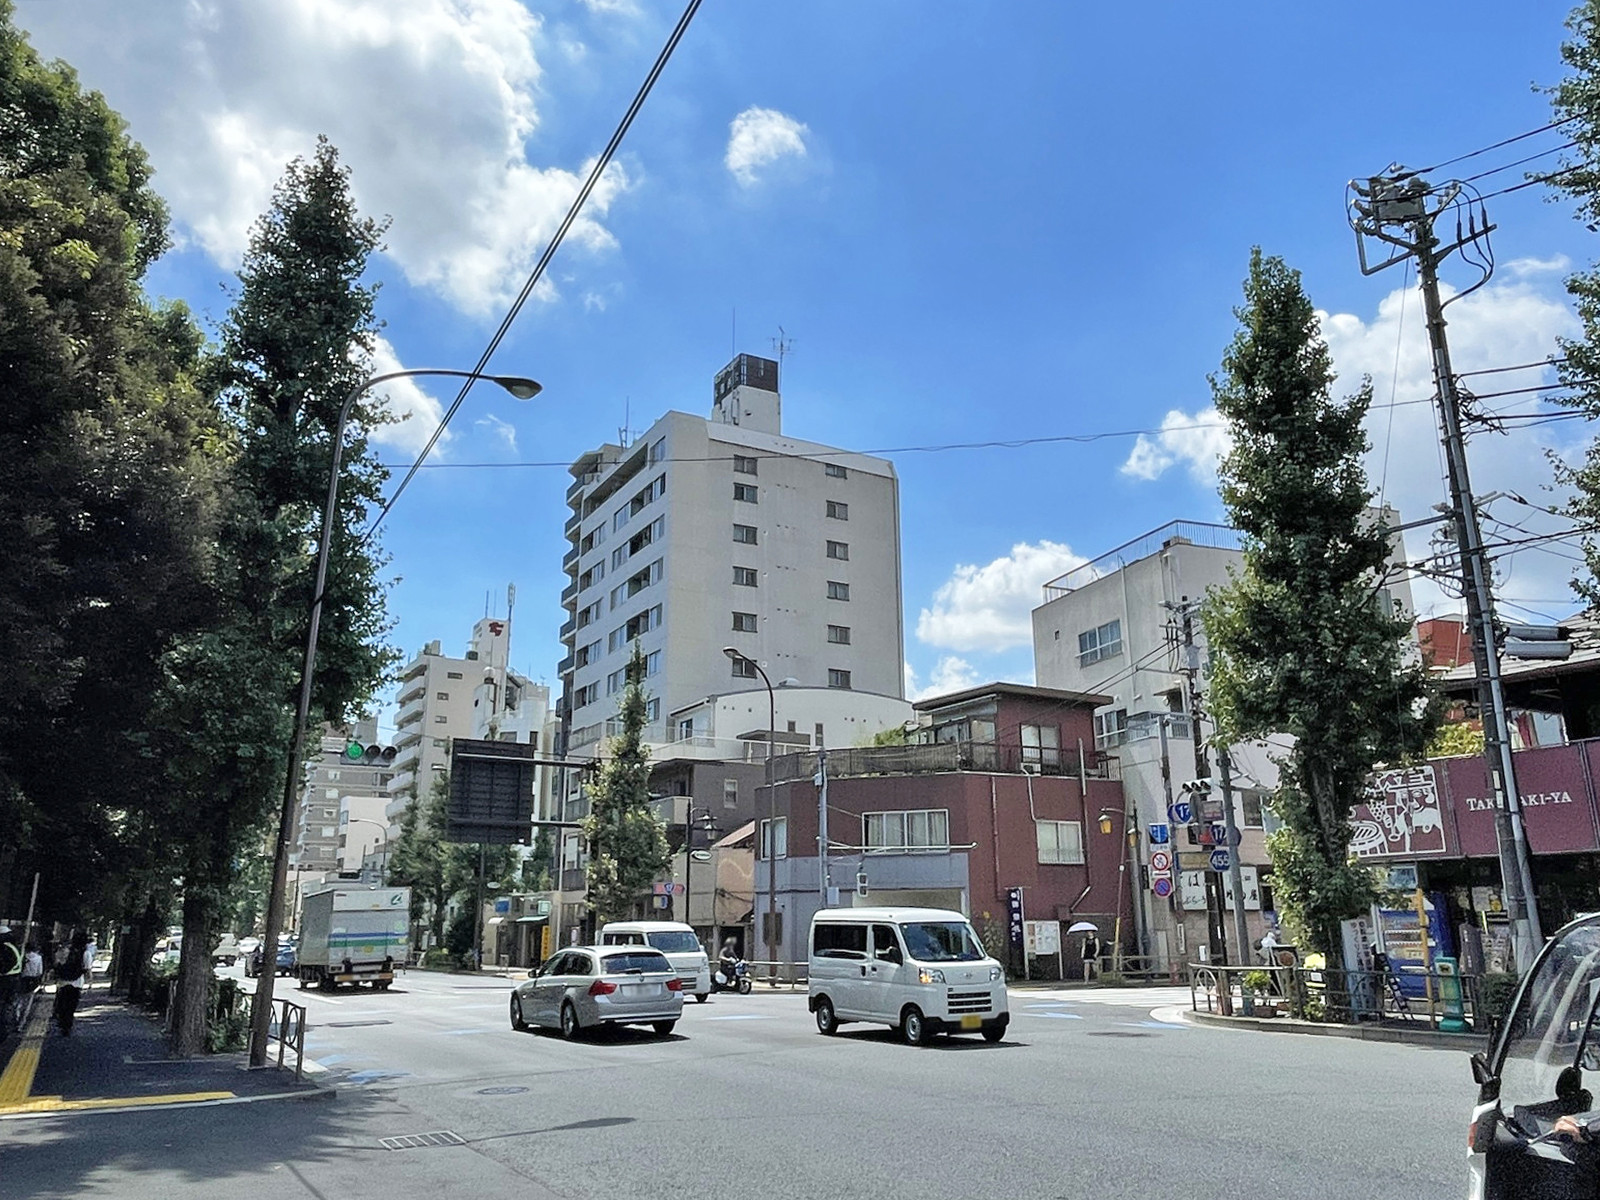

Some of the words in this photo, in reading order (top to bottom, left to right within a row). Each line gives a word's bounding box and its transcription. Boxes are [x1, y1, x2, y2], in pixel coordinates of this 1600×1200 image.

[1467, 792, 1572, 811] TAKAKI-YA
[1214, 826, 1225, 840] 17
[1212, 855, 1230, 867] 455
